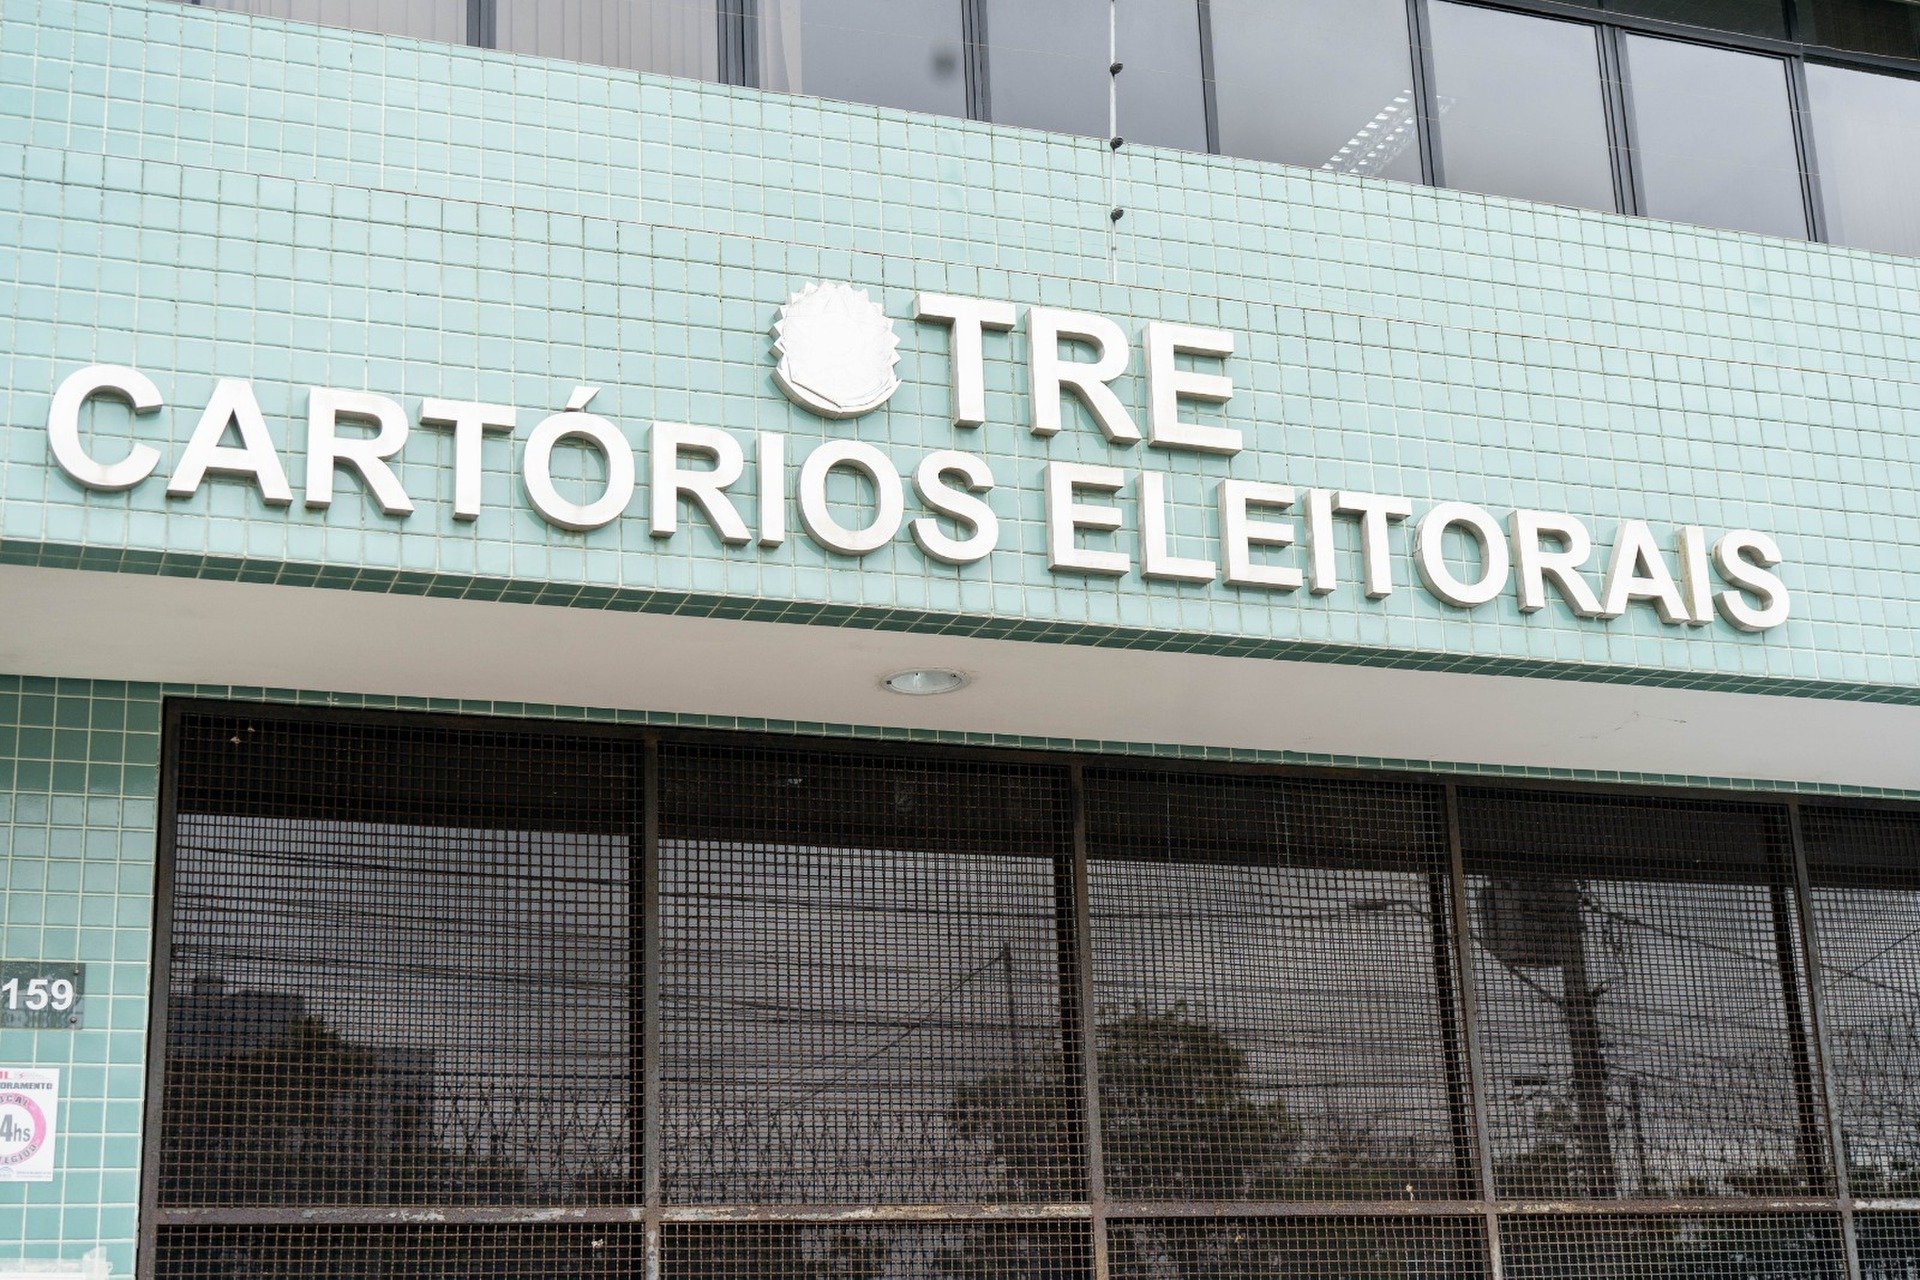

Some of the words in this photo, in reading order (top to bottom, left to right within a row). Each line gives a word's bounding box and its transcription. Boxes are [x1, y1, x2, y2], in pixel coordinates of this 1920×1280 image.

[914, 293, 1243, 457] TRE
[47, 364, 999, 566] CARTÓRIOS
[1044, 461, 1791, 633] ELEITORAIS
[2, 977, 74, 1011] 159
